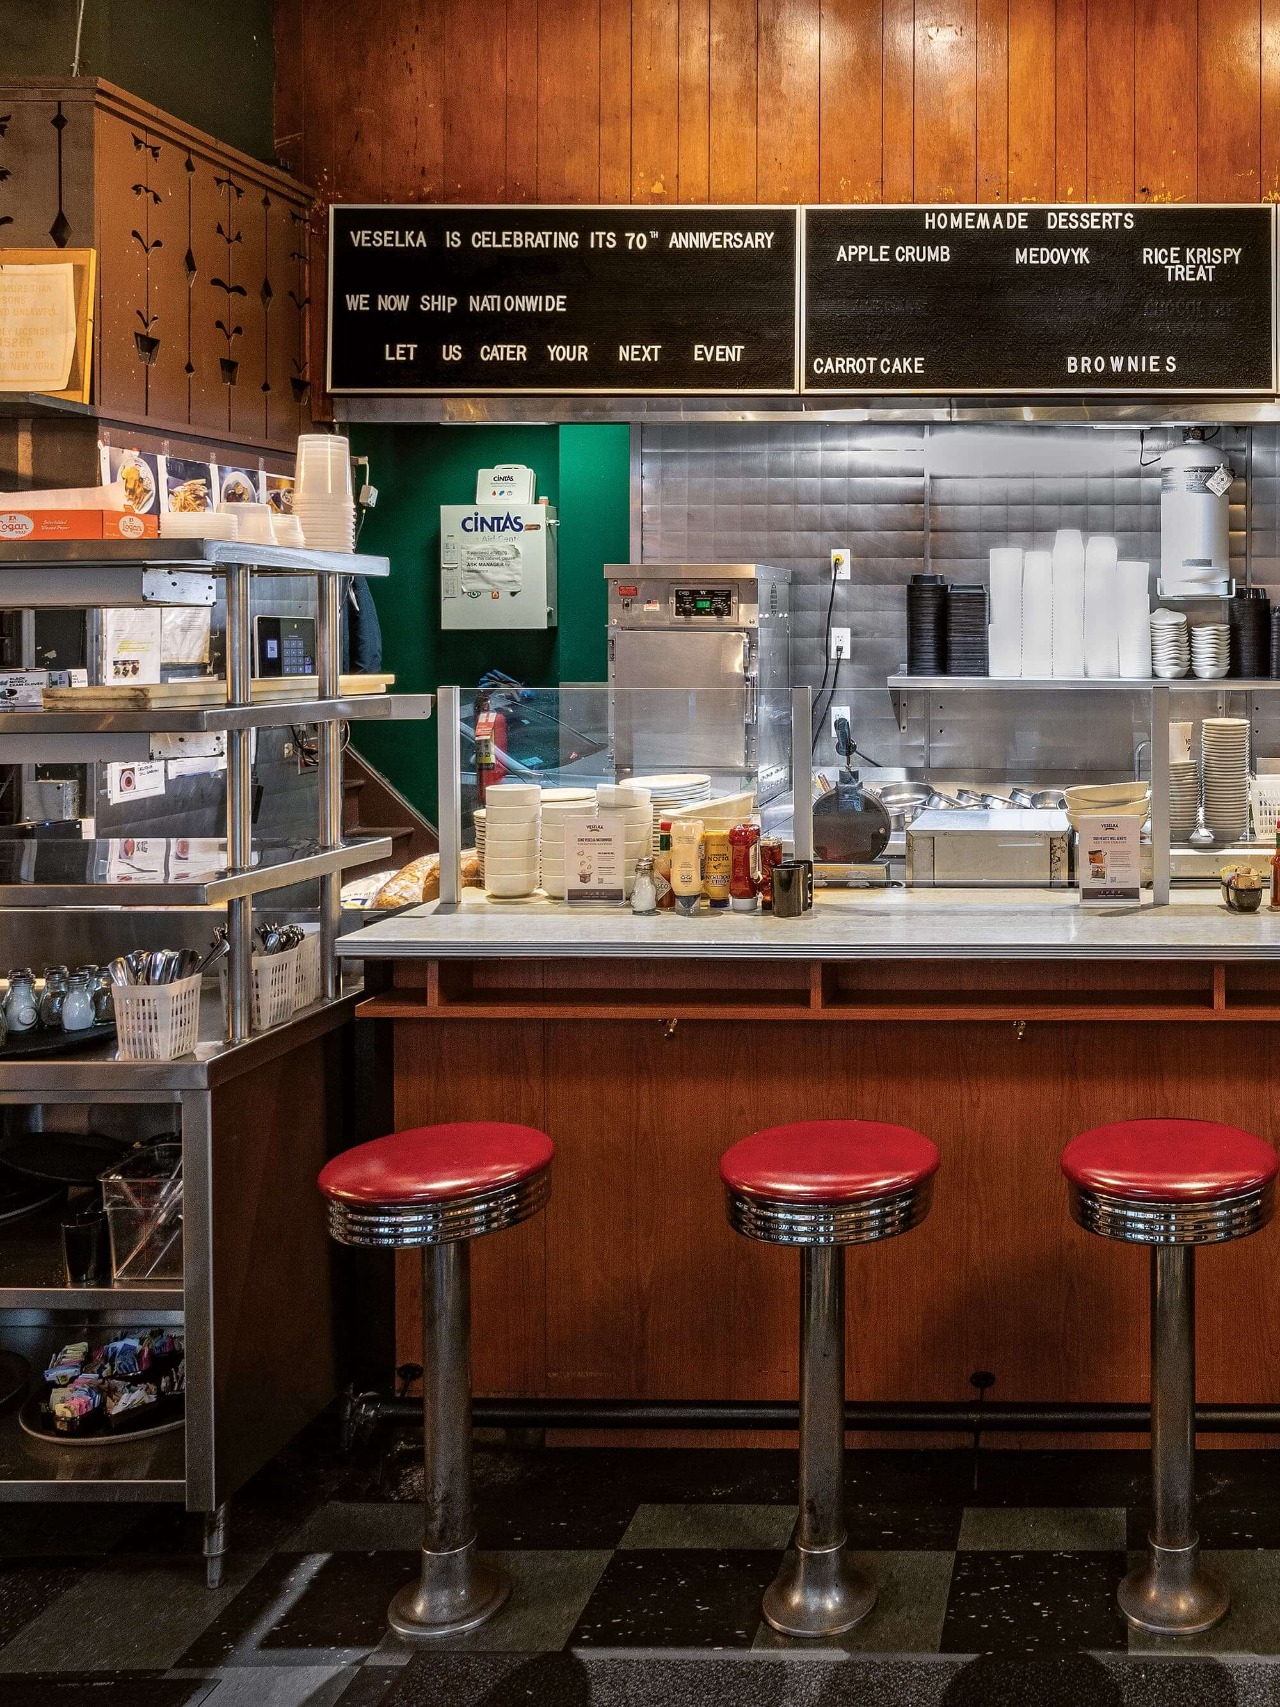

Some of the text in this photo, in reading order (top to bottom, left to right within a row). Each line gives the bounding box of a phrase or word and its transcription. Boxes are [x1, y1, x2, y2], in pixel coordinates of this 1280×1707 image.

[926, 212, 1134, 229] HOMEMADE DESSERTS
[351, 231, 426, 247] VESELKA
[447, 232, 461, 247] IS
[472, 232, 579, 248] CELEBRATING
[591, 232, 616, 248] ITS
[669, 232, 774, 248] ANNIVERSARY
[837, 245, 950, 262] APPLE CRUMB
[1016, 248, 1089, 264] MEDOVYK
[1143, 248, 1242, 264] RICE KRISPY
[1165, 266, 1215, 281] TREAT
[346, 295, 369, 310] WE
[378, 295, 409, 310] NOW
[470, 296, 566, 311] NATIONWIDE
[386, 345, 744, 361] LET US CATER YOUR NEXT EVENT
[814, 357, 924, 374] CARROT CAKE
[1068, 356, 1176, 374] BROWNIES
[493, 474, 514, 482] CINTAS
[461, 511, 524, 532] CINTAS
